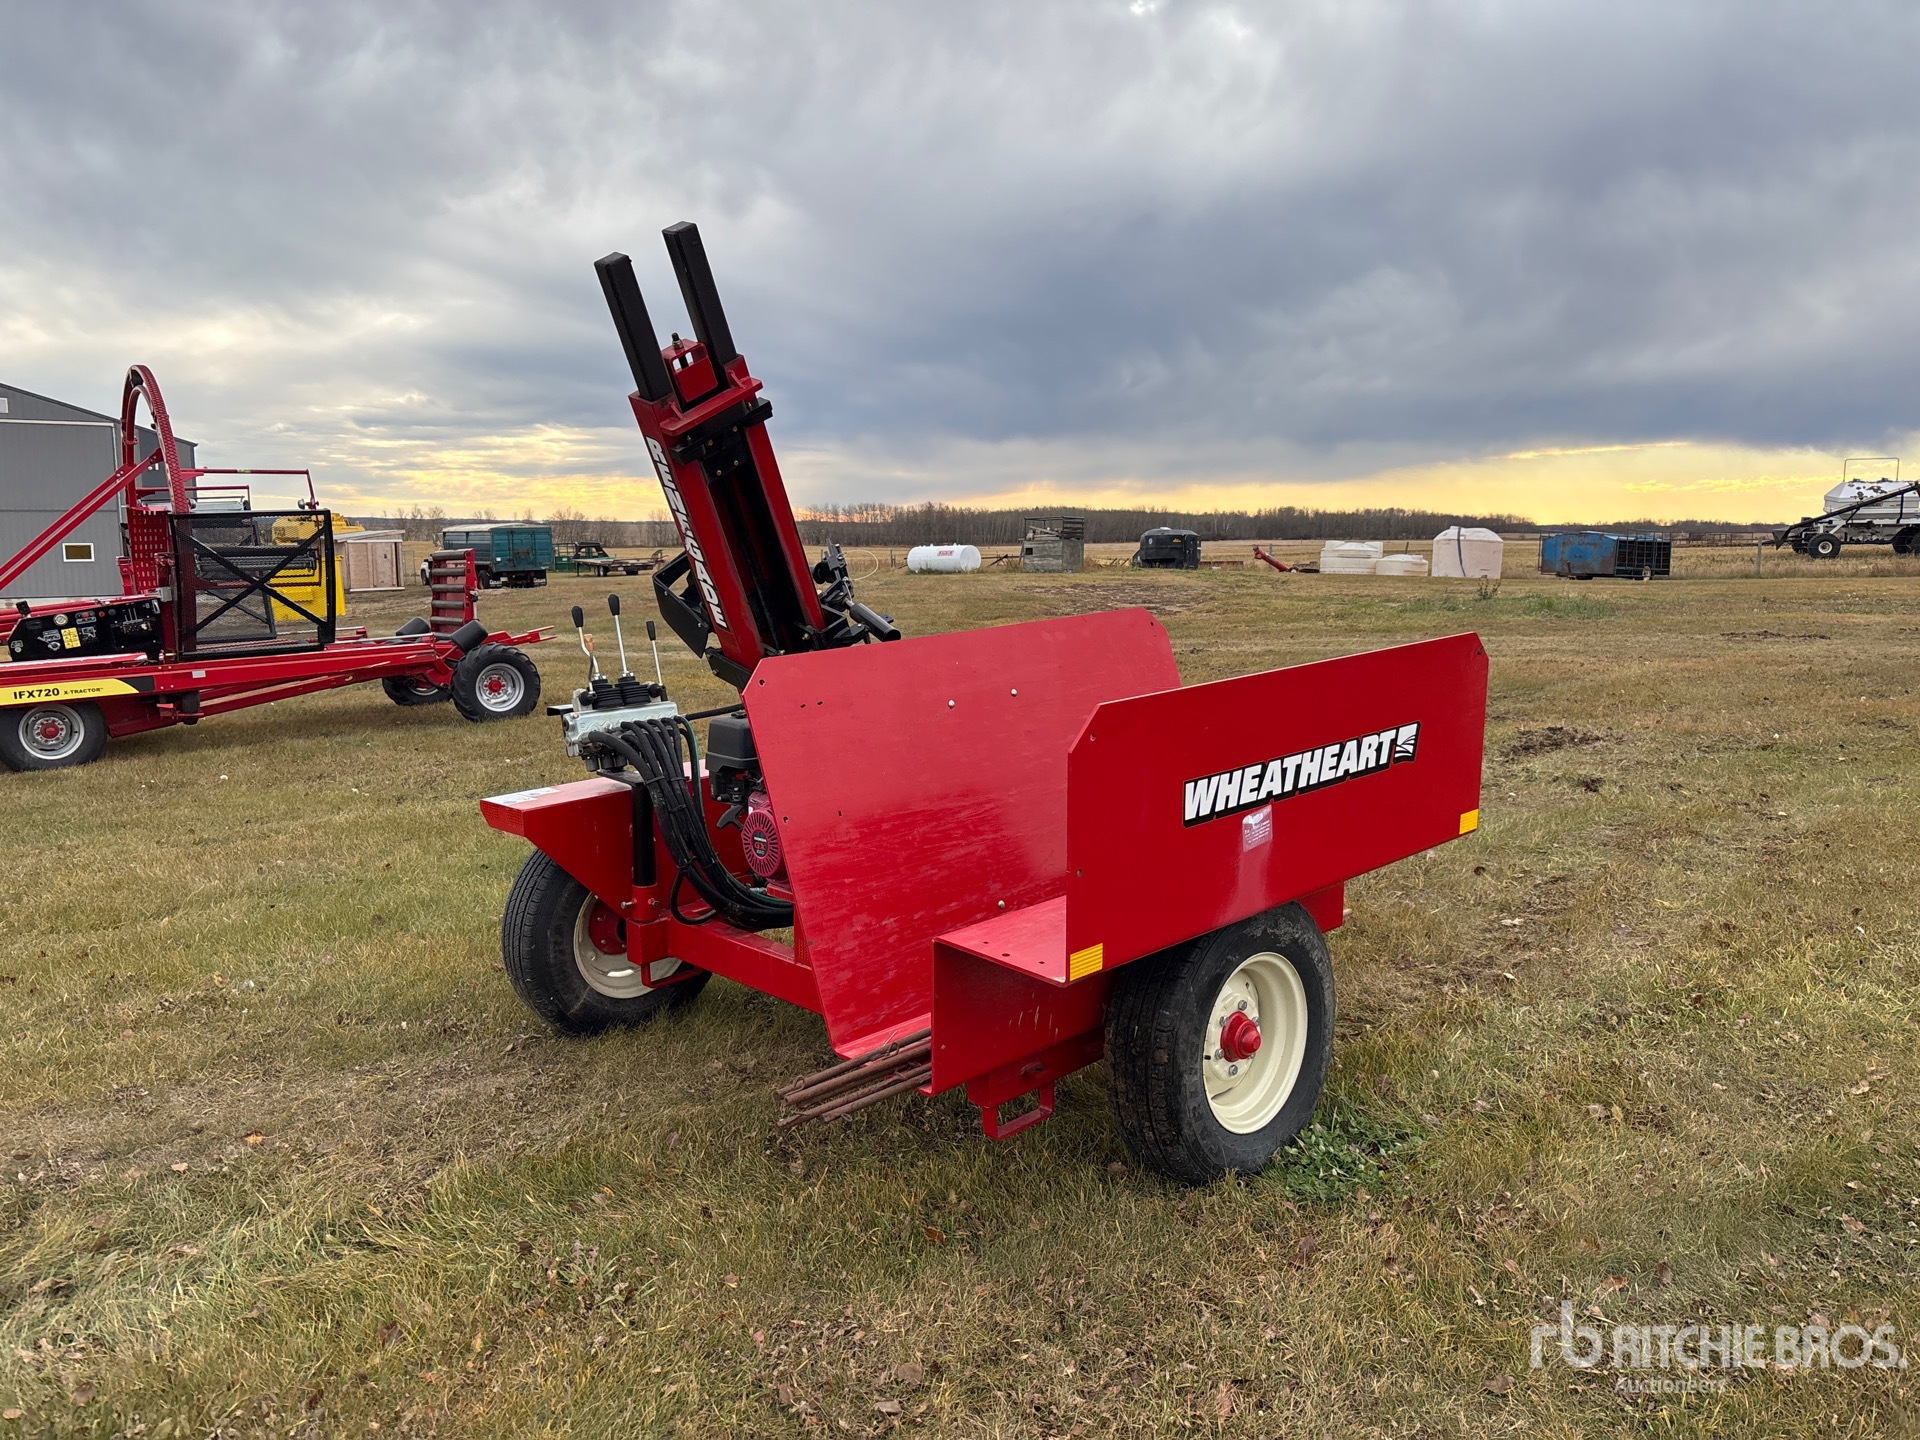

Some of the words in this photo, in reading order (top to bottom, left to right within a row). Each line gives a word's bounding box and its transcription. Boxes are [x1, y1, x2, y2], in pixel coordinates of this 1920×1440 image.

[645, 435, 728, 629] RENEGADE
[13, 688, 60, 700] IFX720
[1184, 728, 1397, 821] WHEATHEART
